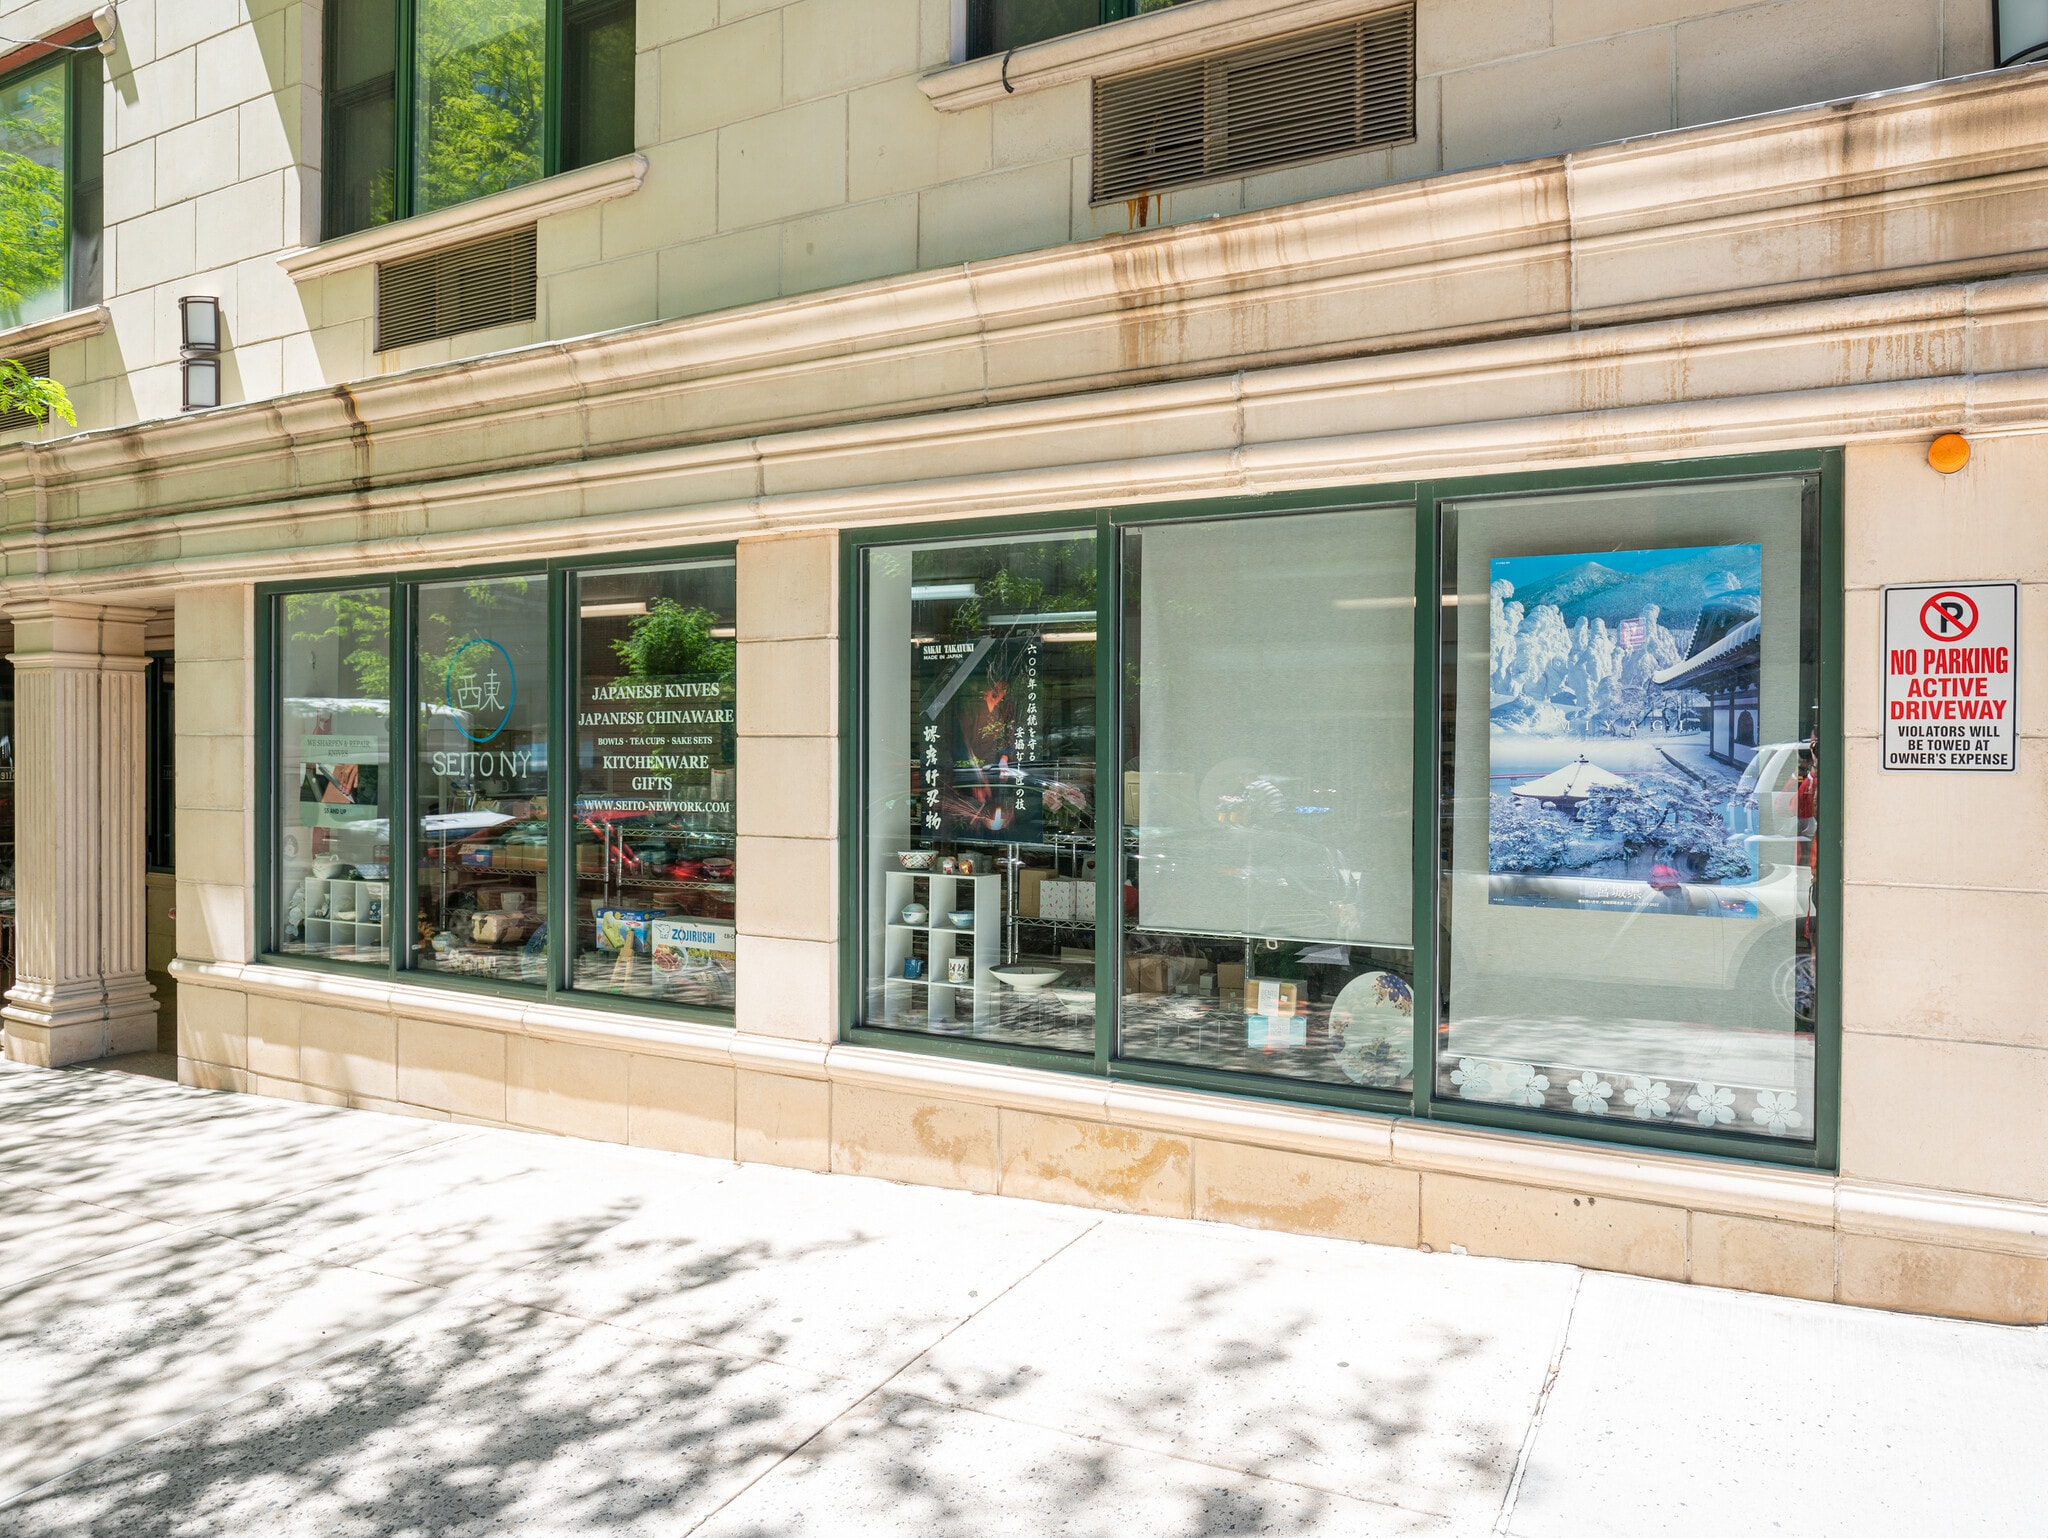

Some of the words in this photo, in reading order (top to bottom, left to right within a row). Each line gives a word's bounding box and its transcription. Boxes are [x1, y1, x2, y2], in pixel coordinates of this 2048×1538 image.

[923, 645, 941, 654] SAKAI
[944, 643, 974, 653] TAKAYUKI
[1891, 649, 1917, 675] NO
[1923, 647, 2009, 675] PARKING
[591, 684, 662, 700] JAPANESE
[665, 682, 720, 698] KNIVES
[1907, 677, 1988, 698] ACTIVE
[1890, 700, 2007, 720] DRIVEWAY
[578, 711, 644, 726] JAPANESE
[646, 709, 735, 725] CHINAWARE
[1560, 720, 1684, 731] MIYAGI
[1898, 725, 1966, 738] VIOLATORS
[1969, 725, 2001, 738] WILL
[316, 739, 343, 747] SHARPEN
[349, 739, 370, 748] REPAIR
[597, 737, 624, 746] BOWLS
[629, 737, 645, 745] TEA
[645, 736, 666, 745] CUPS
[671, 736, 692, 745] SAKE
[693, 736, 713, 745] SETS
[1908, 739, 1923, 751] BE
[1927, 739, 1971, 751] TOWED
[1975, 739, 1990, 751] AT
[328, 749, 349, 757] KNIVES
[1890, 752, 1947, 765] OWNER'S
[1950, 753, 2008, 766] EXPENSE
[431, 751, 494, 778] SEITO
[499, 750, 532, 778] NY
[602, 755, 709, 769] KITCHENWARE
[631, 776, 673, 791] GIFTS
[330, 807, 340, 815] AND
[584, 800, 730, 813] WWW.SEITO-NEWYORK.COM
[671, 927, 716, 944] ZOJIRUSHI
